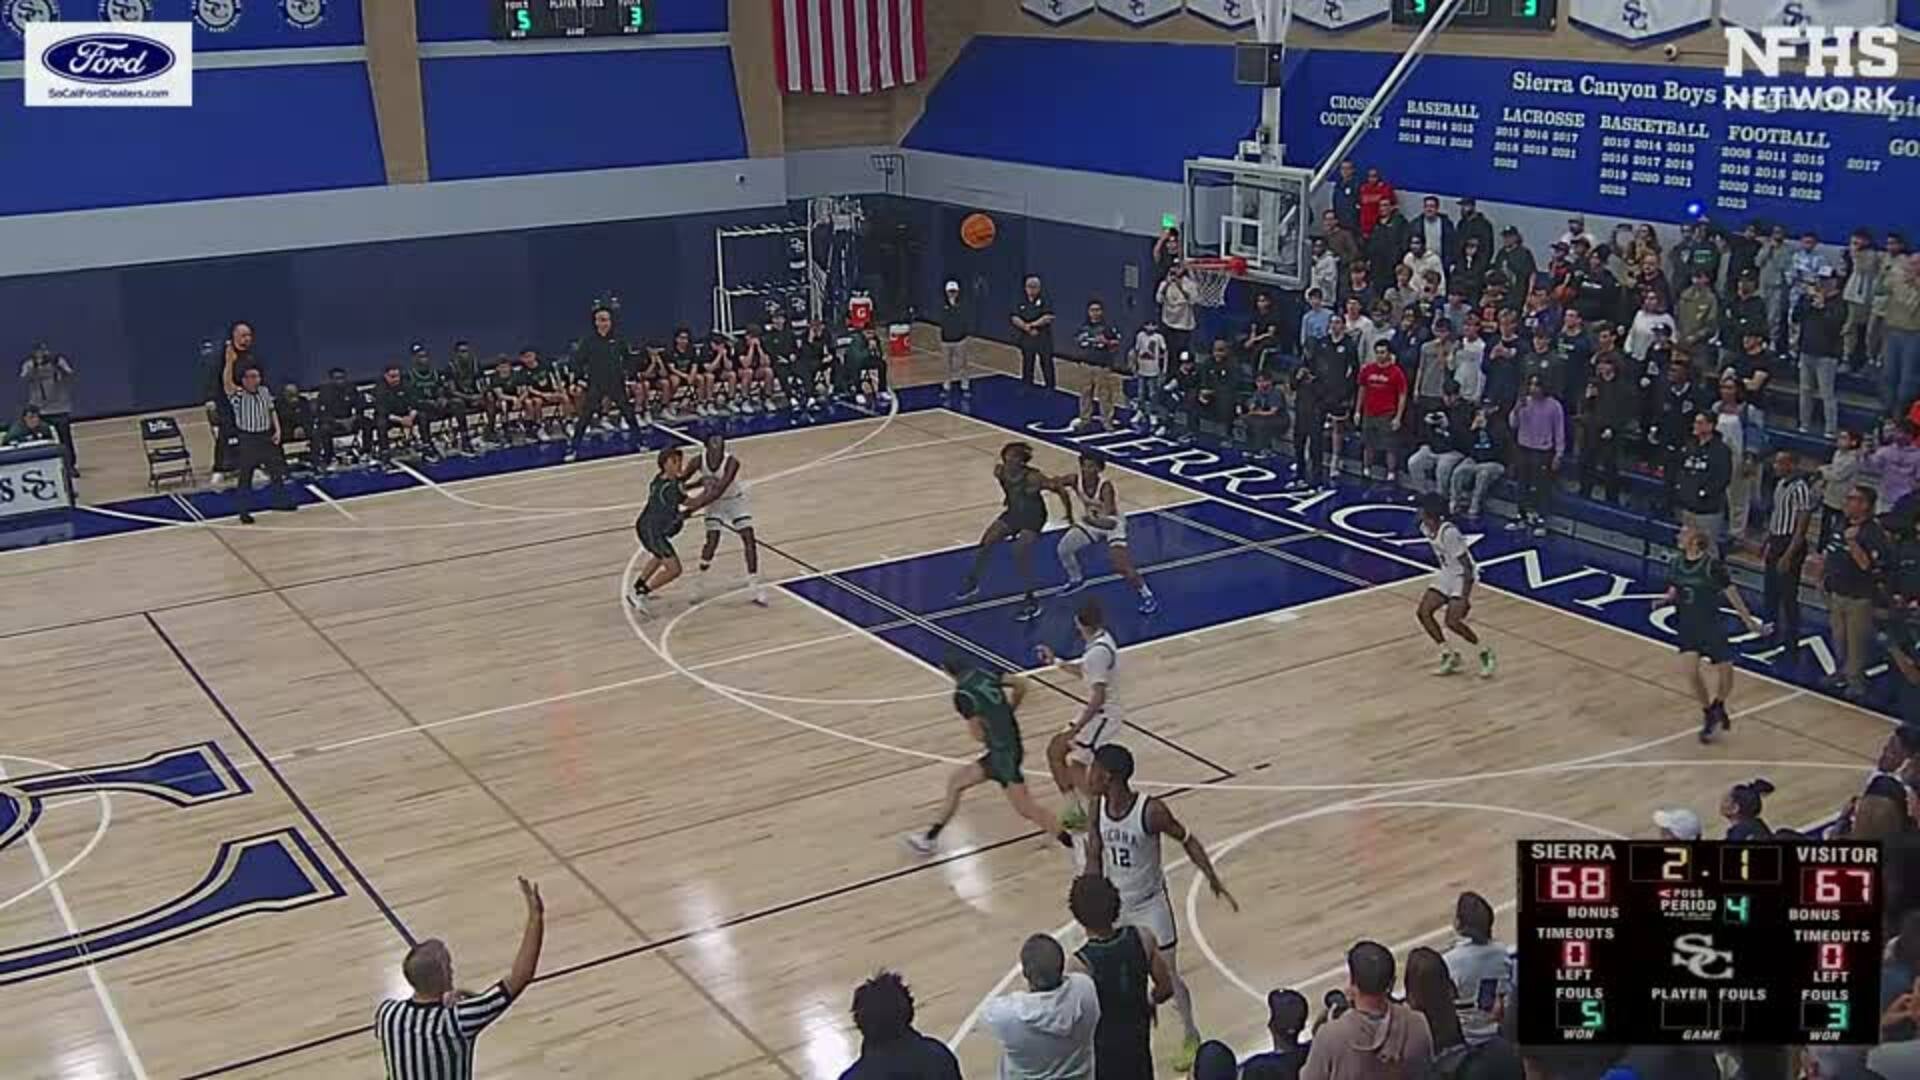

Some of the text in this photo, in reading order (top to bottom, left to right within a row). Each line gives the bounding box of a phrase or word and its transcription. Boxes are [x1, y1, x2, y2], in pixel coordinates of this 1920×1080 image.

[516, 9, 532, 30] 5
[630, 6, 642, 26] 3
[1513, 71, 1574, 93] Sierra
[1580, 75, 1657, 102] Canyon
[1663, 81, 1717, 107] Boys
[1407, 100, 1479, 119] BASEBALL
[1503, 107, 1585, 128] LACROSSE
[1320, 112, 1383, 129] COUNY
[1600, 115, 1710, 139] BASKETBALL
[1728, 125, 1831, 148] FOOTBALL
[1757, 149, 1787, 162] 2011
[1889, 139, 1920, 157] GO
[1846, 157, 1881, 171] 2017
[1754, 183, 1784, 197] 2021
[21, 469, 58, 501] SC
[1111, 847, 1131, 868] 12
